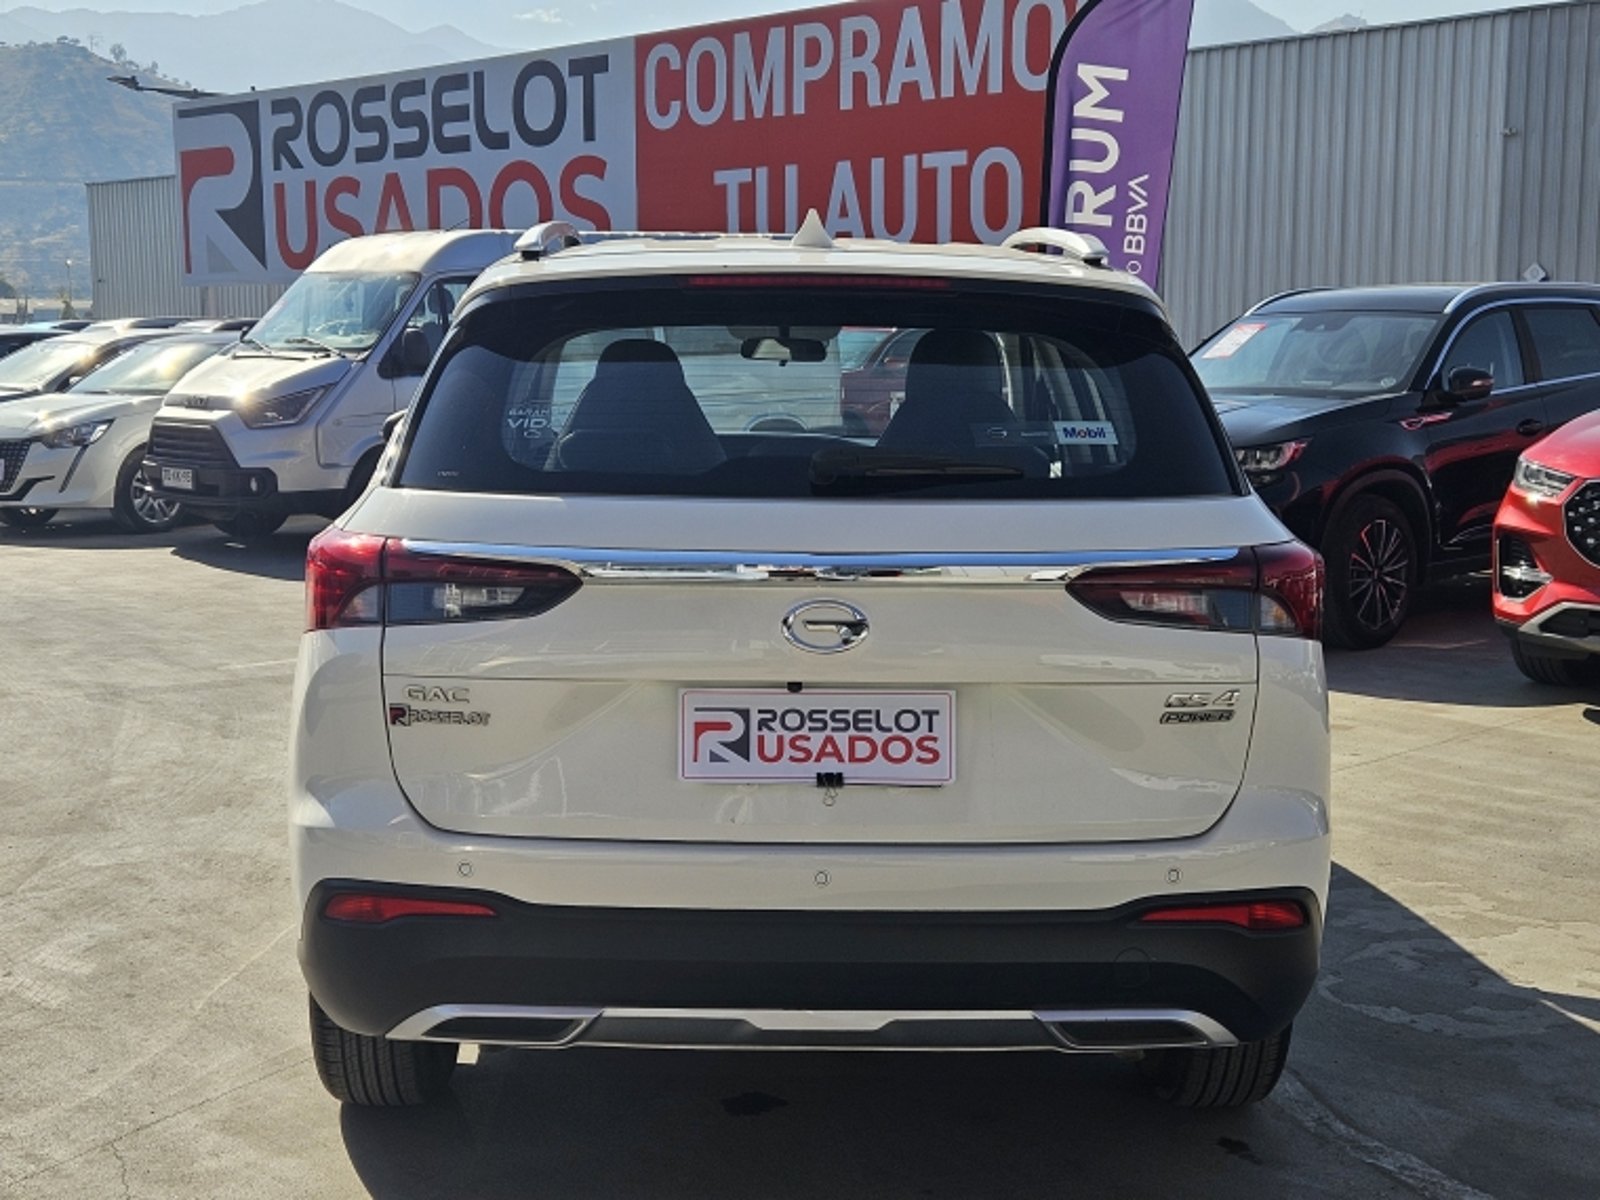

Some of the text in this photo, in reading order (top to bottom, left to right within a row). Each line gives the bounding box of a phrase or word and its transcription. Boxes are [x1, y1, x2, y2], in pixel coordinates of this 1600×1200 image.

[644, 0, 1088, 131] COMPRAMO
[270, 54, 609, 172] ROSSELOT
[1064, 63, 1129, 228] RUM
[274, 154, 613, 271] USADOS
[823, 146, 1023, 244] AUTO
[1123, 173, 1150, 255] BBVA
[1062, 426, 1106, 439] Mobil
[405, 685, 470, 703] GAC
[757, 708, 940, 733] ROSSELOT
[1164, 690, 1240, 707] GS4
[756, 734, 941, 765] USADOS
